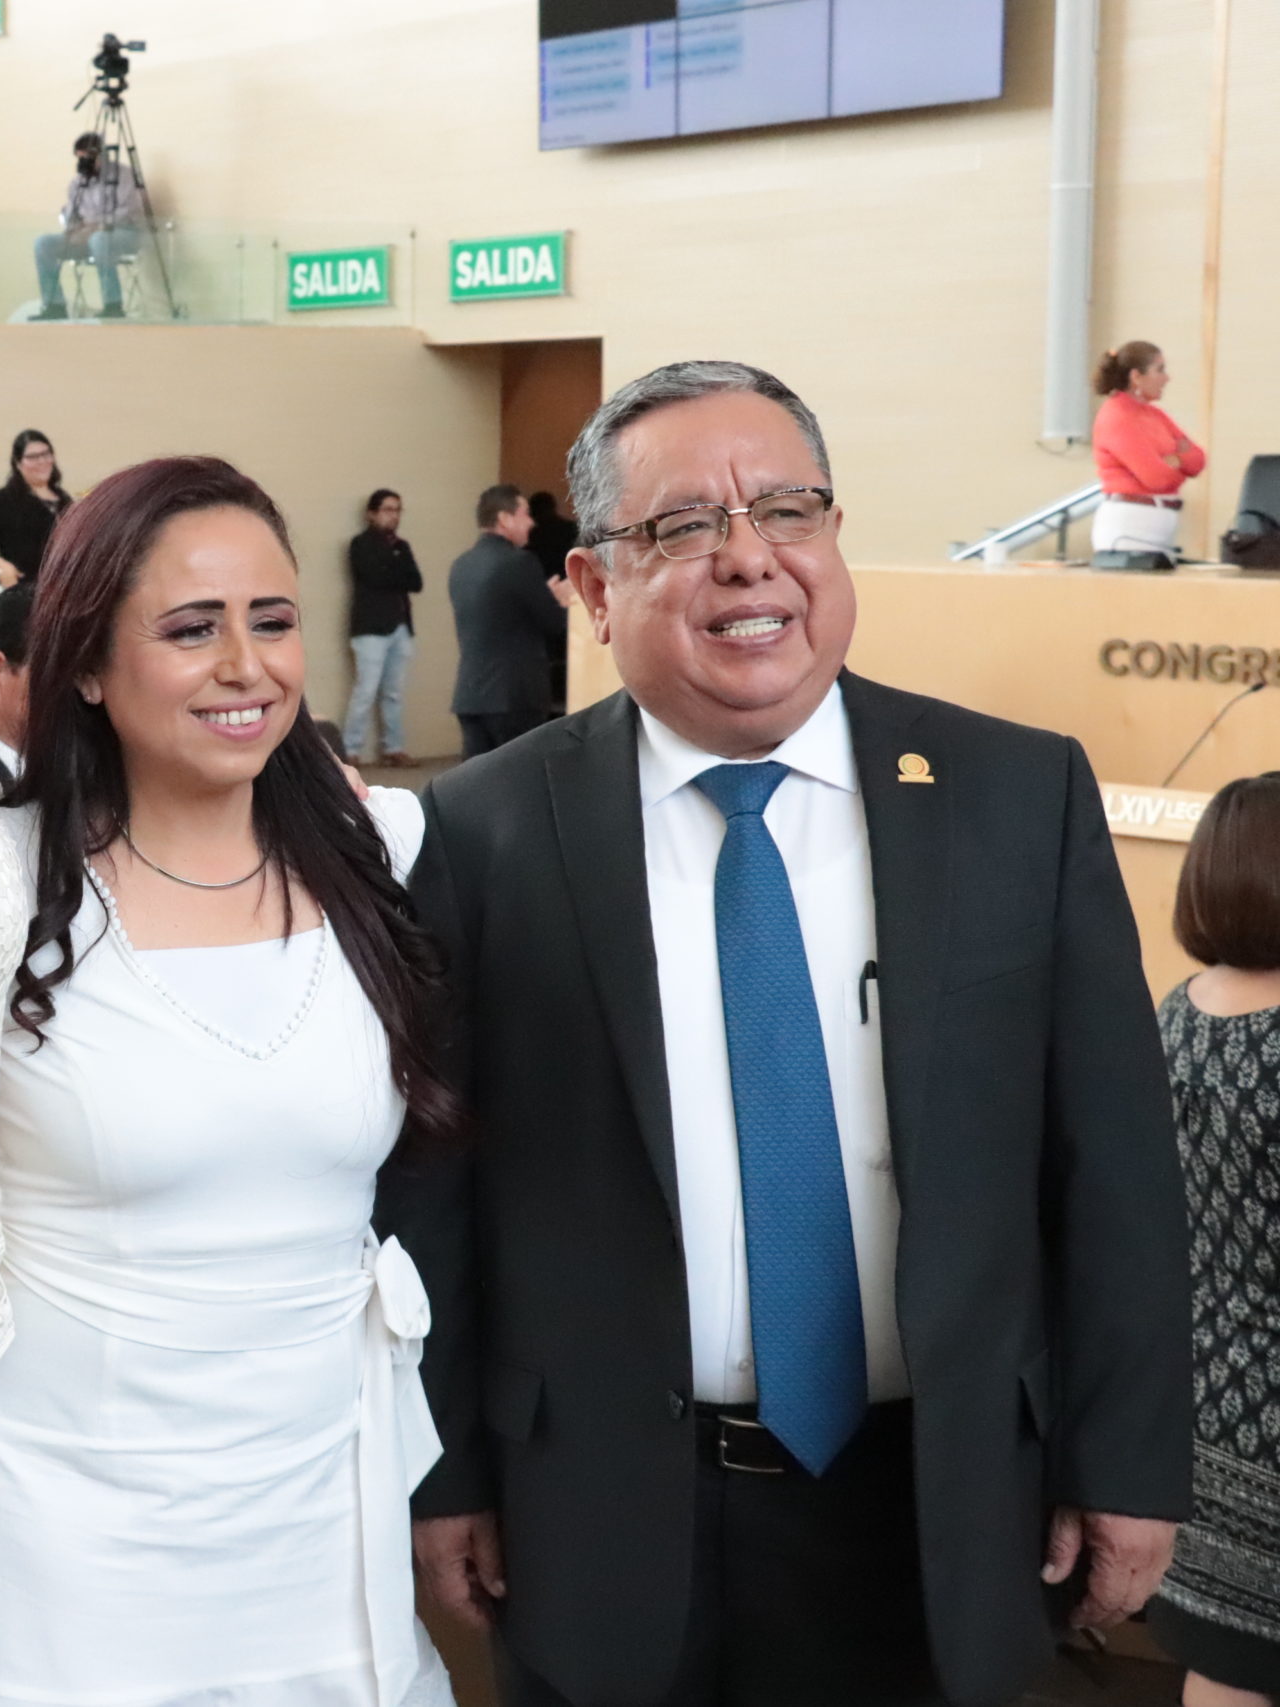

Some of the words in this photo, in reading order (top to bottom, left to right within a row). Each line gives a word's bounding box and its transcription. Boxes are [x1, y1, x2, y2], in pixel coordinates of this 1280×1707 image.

[293, 258, 381, 298] SALIDA
[455, 244, 556, 289] SALIDA
[1104, 792, 1167, 825] LXIV
[1165, 801, 1206, 821] LEG
